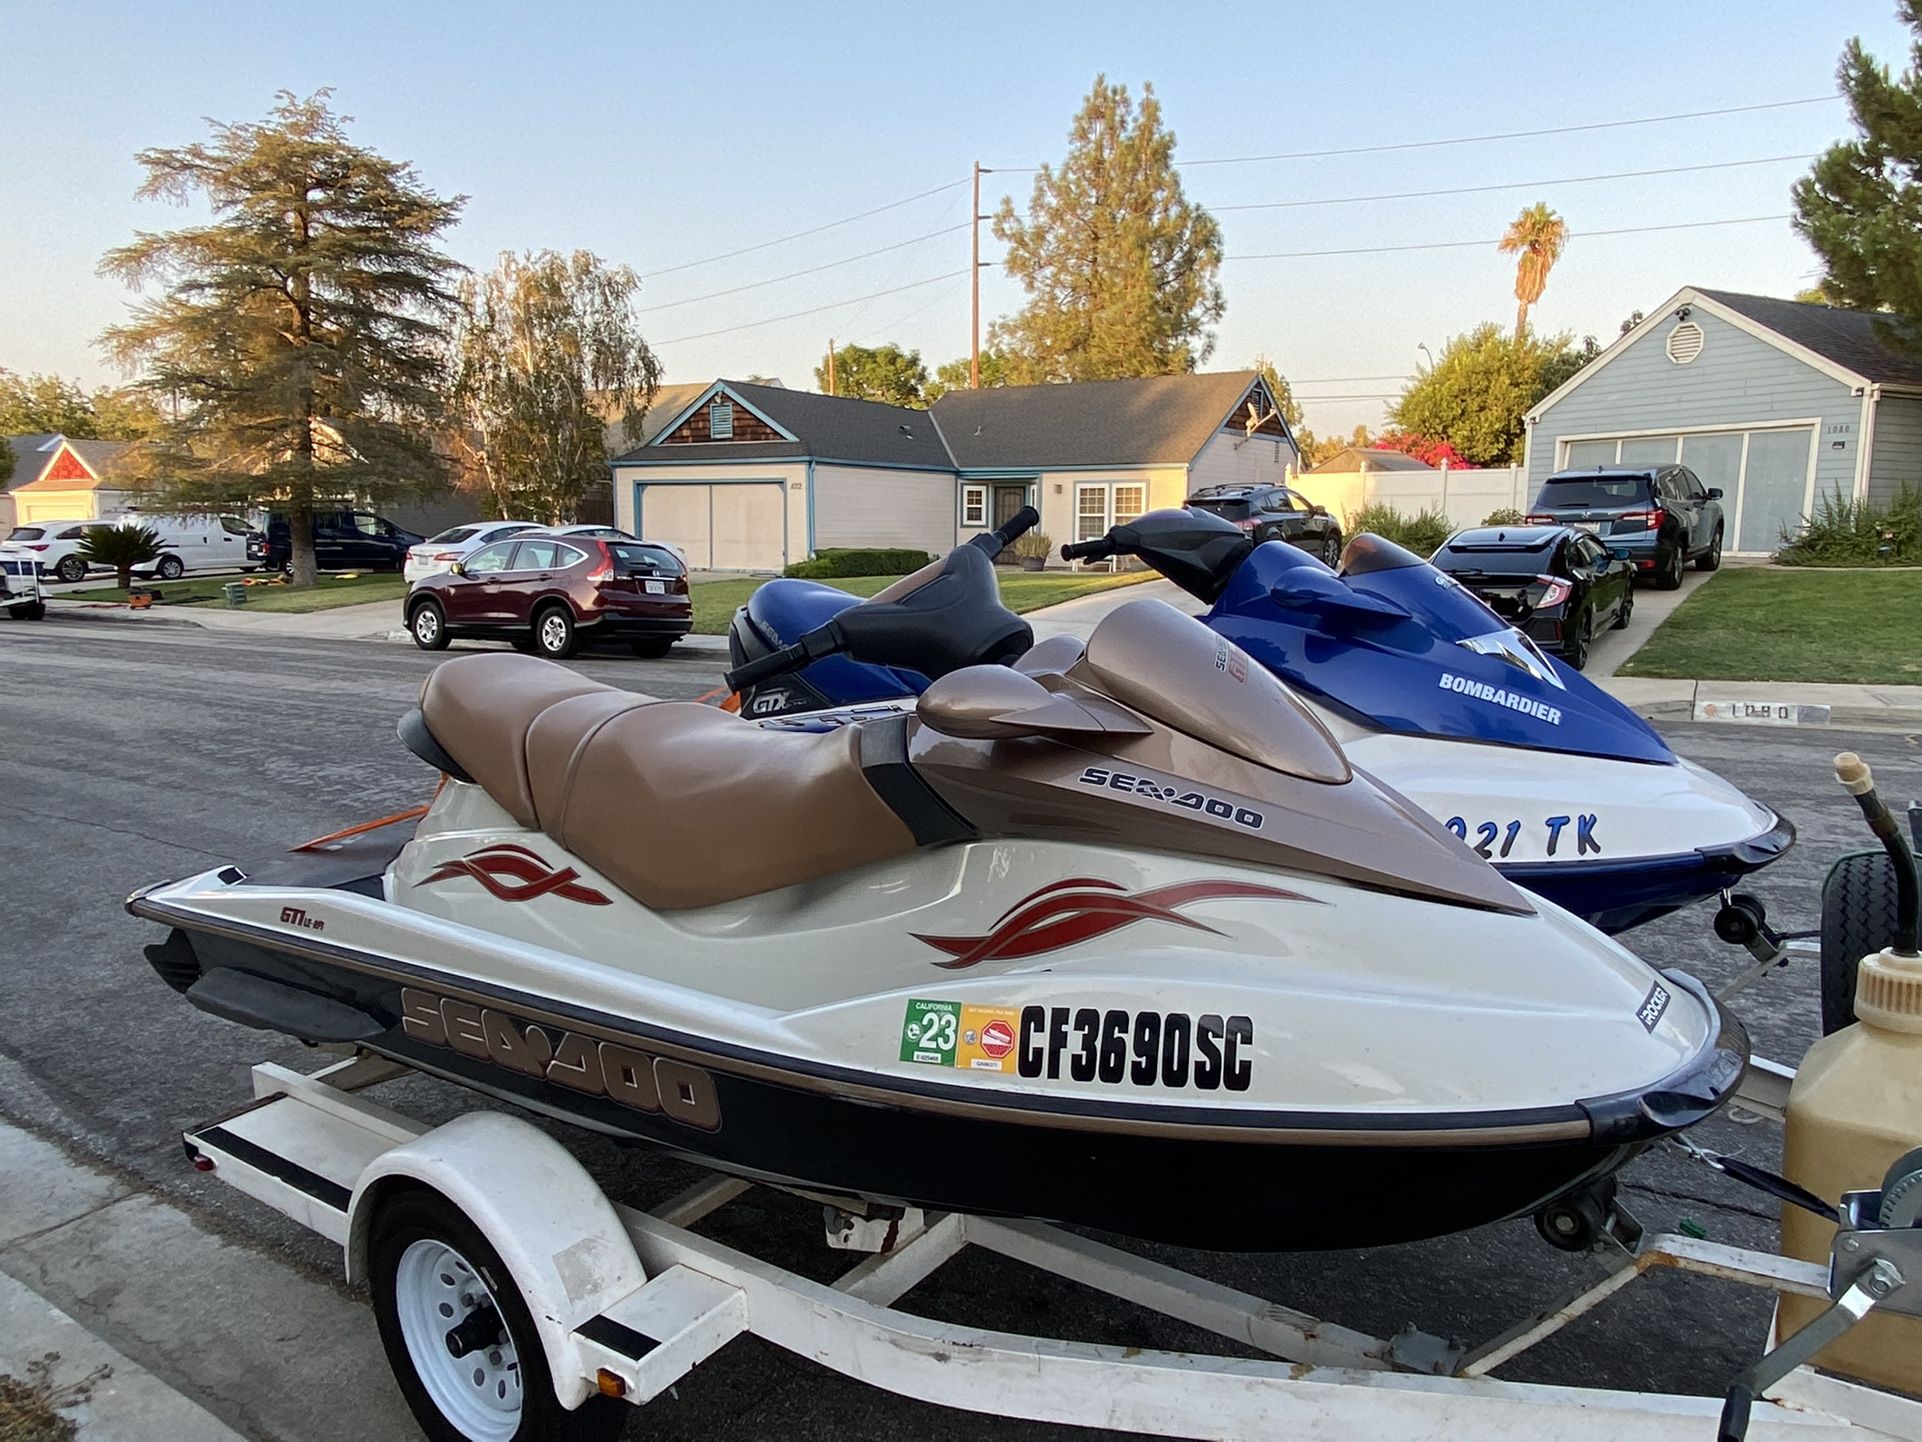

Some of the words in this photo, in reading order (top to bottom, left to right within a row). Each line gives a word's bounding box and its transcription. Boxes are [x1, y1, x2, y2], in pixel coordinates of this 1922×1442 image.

[753, 689, 792, 714] GTX
[1438, 673, 1562, 726] BOMBARDIER
[1546, 813, 1602, 857] TK
[915, 1002, 953, 1012] CALIFORNIA
[918, 1012, 957, 1051] 23
[1018, 1005, 1253, 1091] CF3690SC
